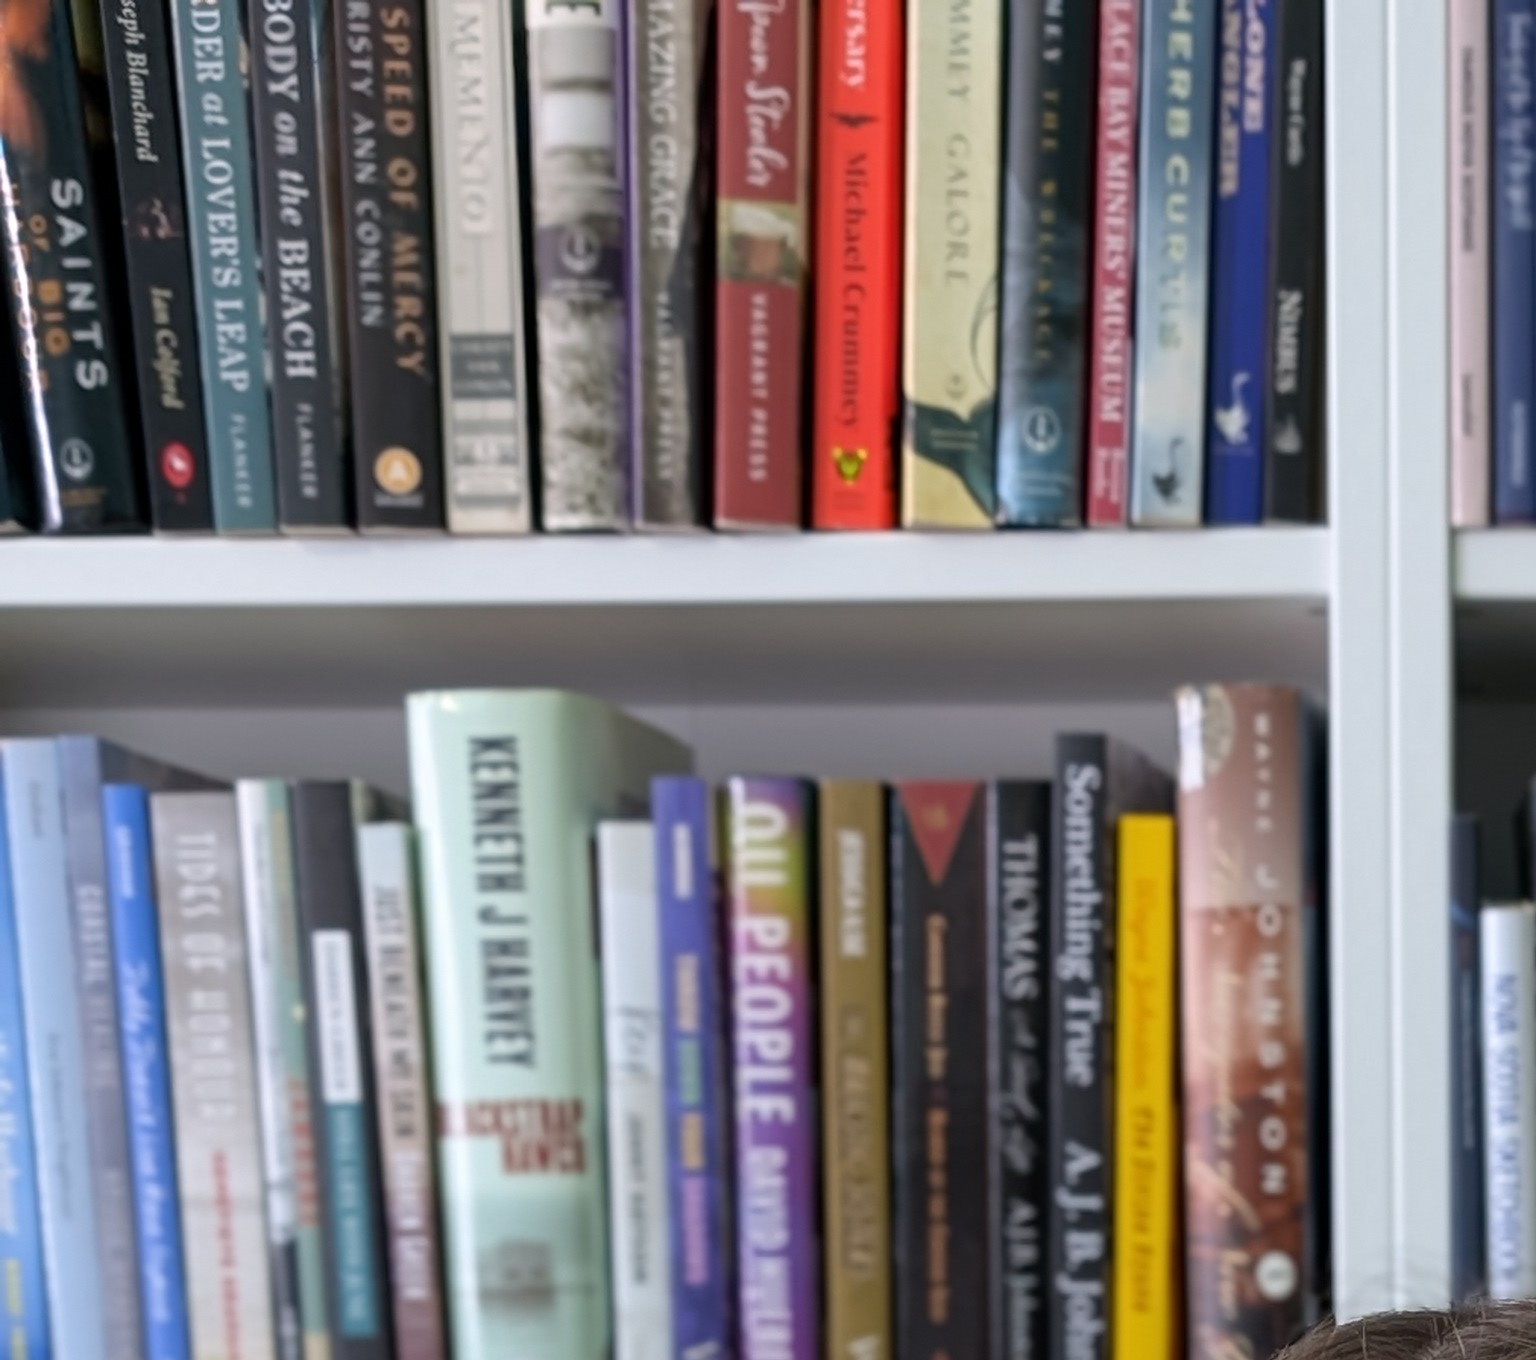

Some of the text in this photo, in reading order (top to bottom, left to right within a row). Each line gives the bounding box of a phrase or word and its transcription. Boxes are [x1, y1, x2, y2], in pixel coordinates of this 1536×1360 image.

[125, 52, 158, 162] Blanchard
[201, 94, 226, 128] at
[351, 112, 379, 185] ANN
[1041, 91, 1059, 151] THE
[1106, 91, 1131, 147] BAY
[201, 138, 240, 288] LOVER'S
[262, 0, 318, 379] BODY on the BEACH
[381, 8, 426, 380] SPEED OF MERCY
[650, 135, 678, 249] GRACE
[945, 135, 972, 287] GALORE
[1102, 152, 1130, 280] MINERS'
[1158, 155, 1190, 352] CURTIS
[50, 178, 108, 392] SAINTS
[357, 201, 387, 328] CONLIN
[836, 152, 868, 428] Michael Crummey
[151, 288, 184, 408] Ian Colford
[212, 300, 249, 393] LEAP
[655, 292, 673, 481] VAGRANT PRESS
[749, 293, 767, 481] VAGRANT PRESS
[1099, 285, 1127, 422] MUSEUM
[231, 414, 251, 508] FLANKER
[294, 403, 318, 498] FLANKER
[176, 832, 228, 976] TIDES OF
[373, 886, 408, 936] JUST
[467, 736, 537, 1069] KENNETH J HARVEY
[732, 802, 794, 1123] OIL PEOPLE
[1002, 833, 1038, 999] THOMAS
[1055, 764, 1102, 1086] Something True
[1255, 713, 1287, 1193] WAYNE JOHNSTON
[1065, 1142, 1102, 1185] A.
